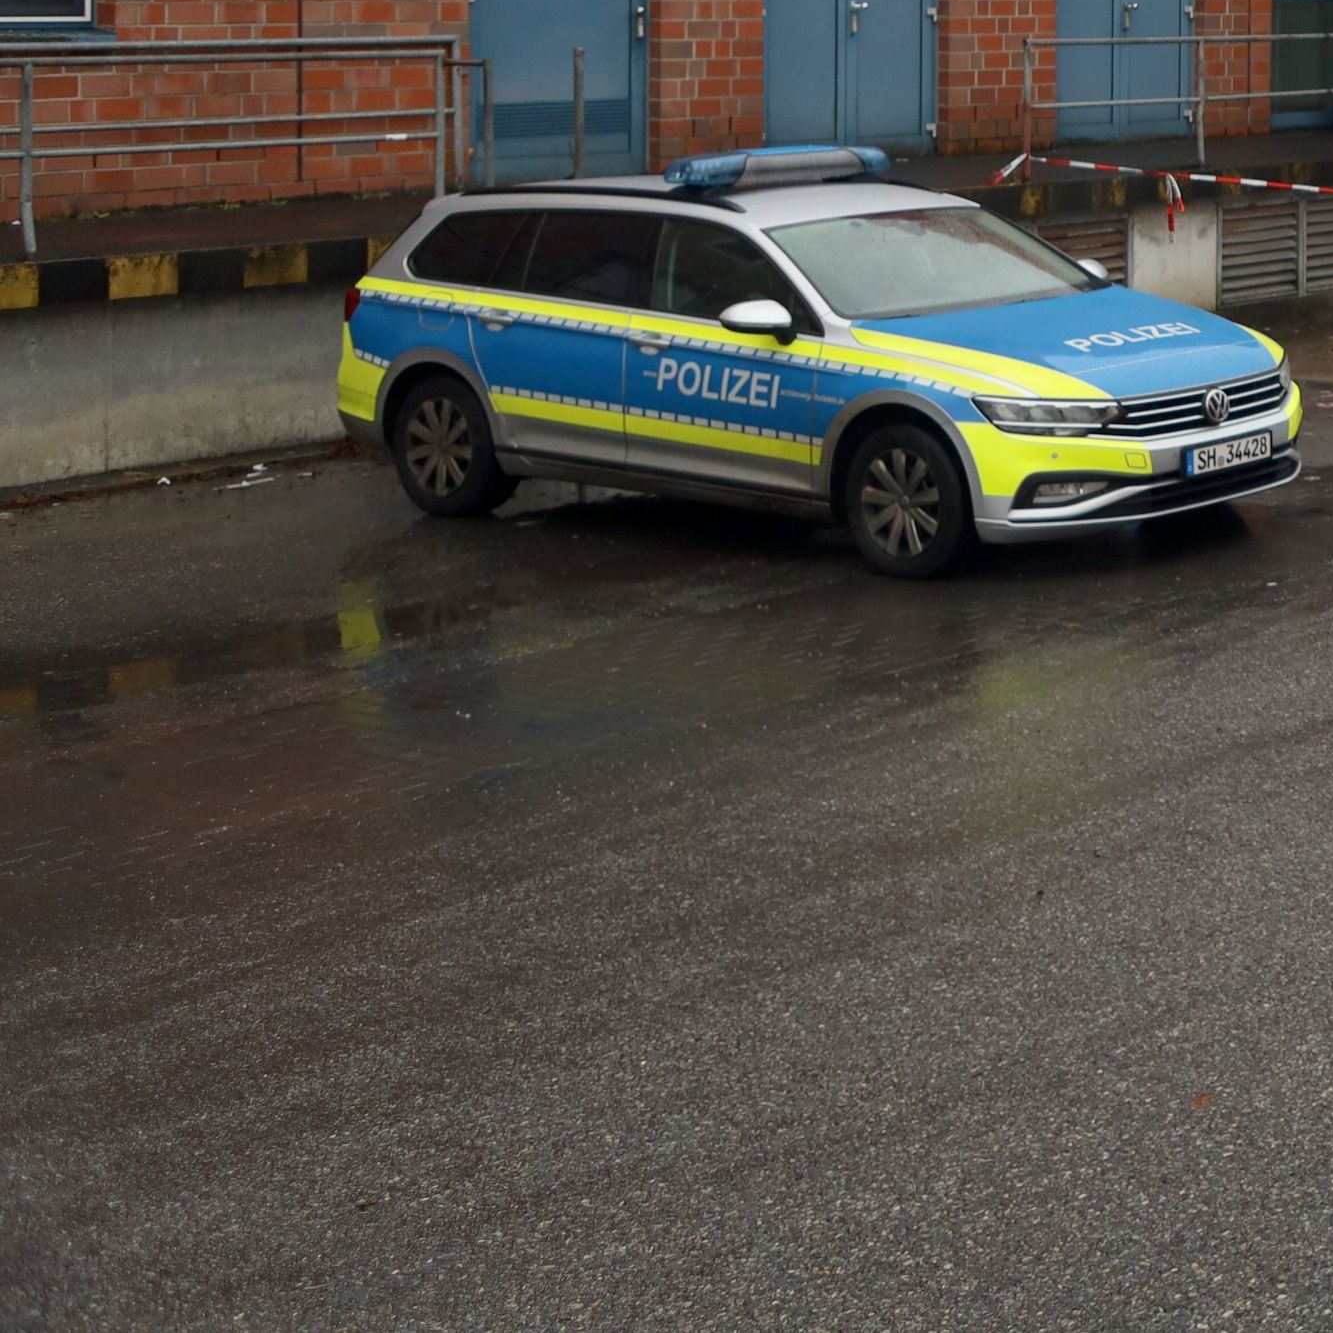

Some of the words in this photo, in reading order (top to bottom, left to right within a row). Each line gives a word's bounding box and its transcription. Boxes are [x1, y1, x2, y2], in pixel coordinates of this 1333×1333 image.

[1064, 321, 1202, 353] POLIZEI
[657, 357, 781, 409] POLIZEI
[1197, 448, 1217, 470] SH
[1226, 436, 1267, 463] 34428
